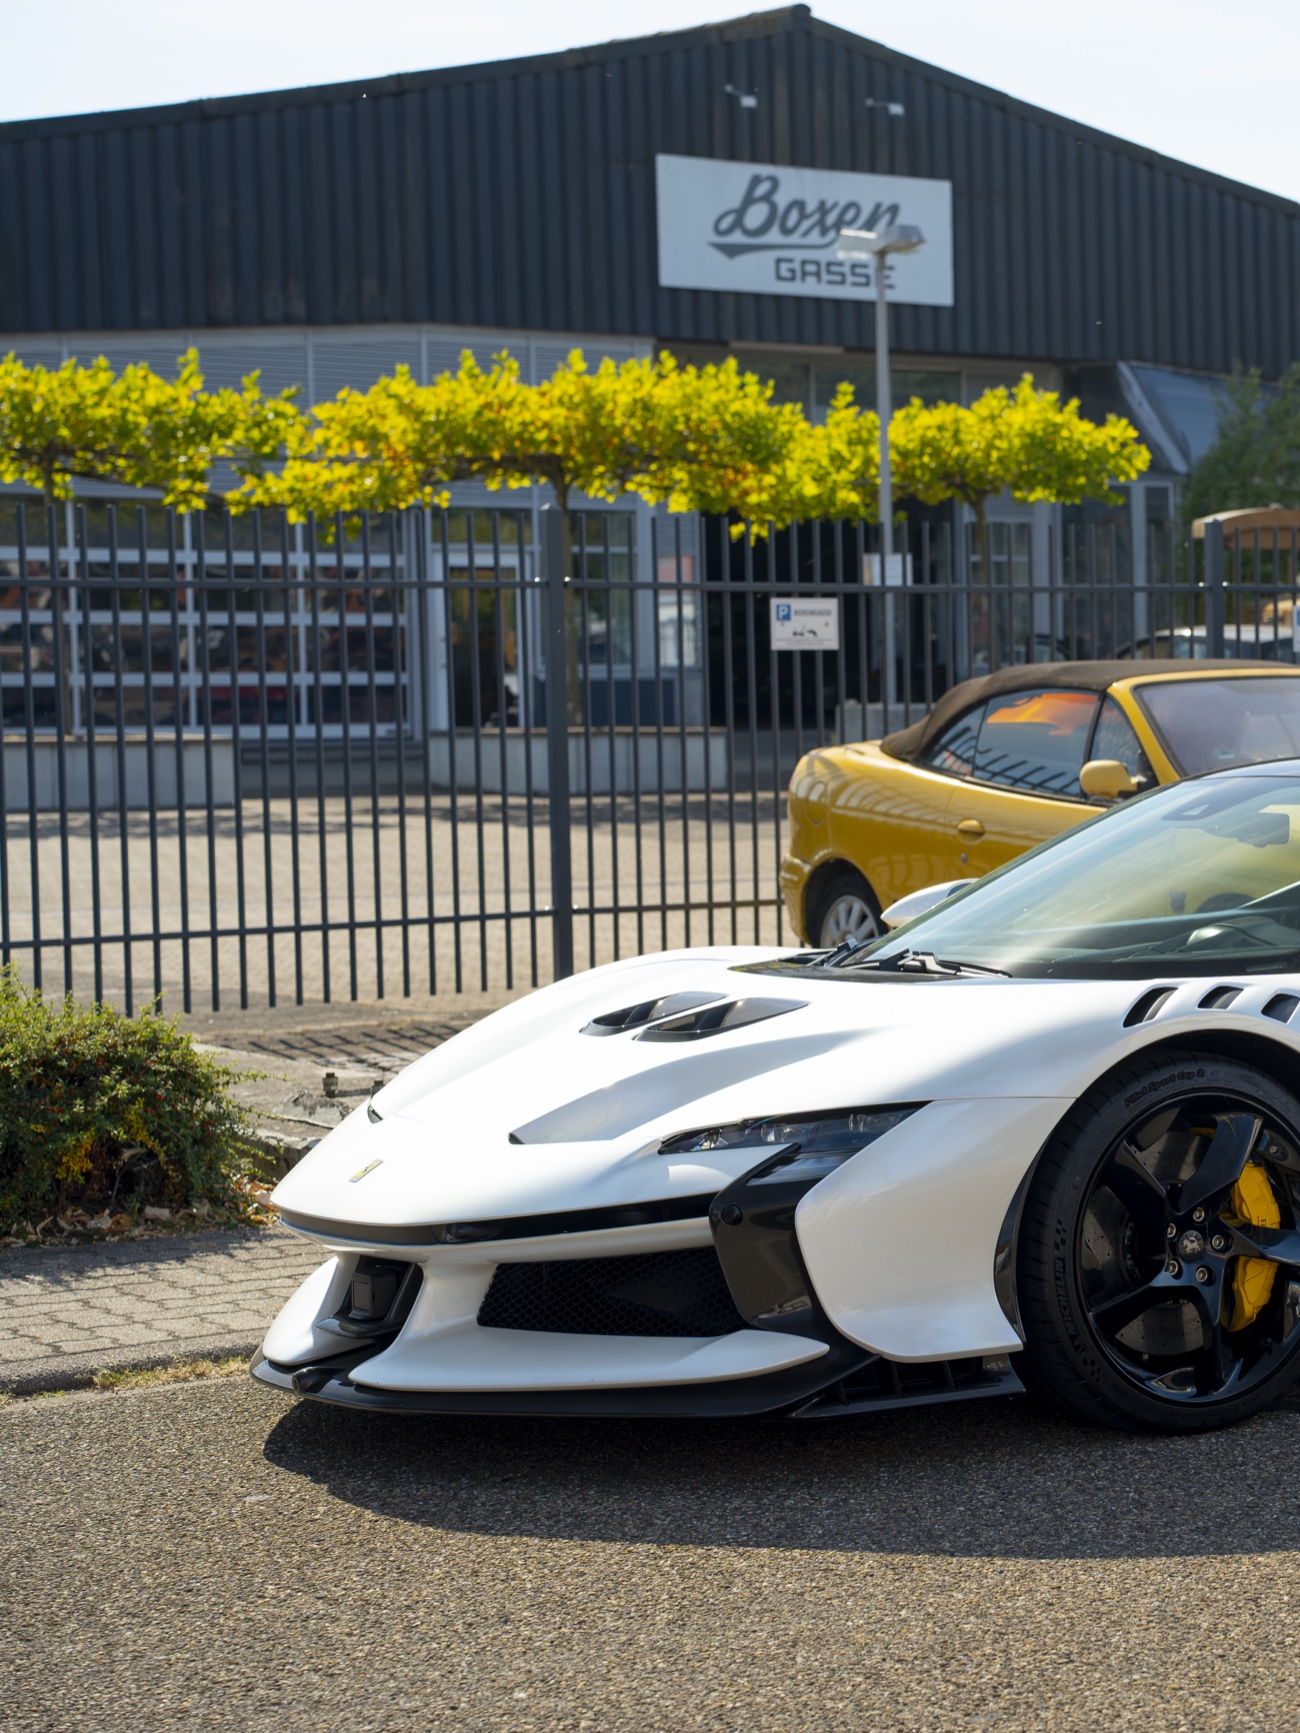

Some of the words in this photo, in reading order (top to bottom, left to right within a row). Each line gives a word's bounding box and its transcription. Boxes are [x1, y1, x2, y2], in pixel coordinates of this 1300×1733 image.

[712, 173, 901, 239] Boxen
[774, 257, 896, 290] GASSE
[1124, 1086, 1149, 1109] Pilot
[1147, 1073, 1177, 1093] Sport
[1177, 1070, 1196, 1081] Cup
[1196, 1068, 1205, 1078] 2
[1054, 1258, 1079, 1336] MICHELIN
